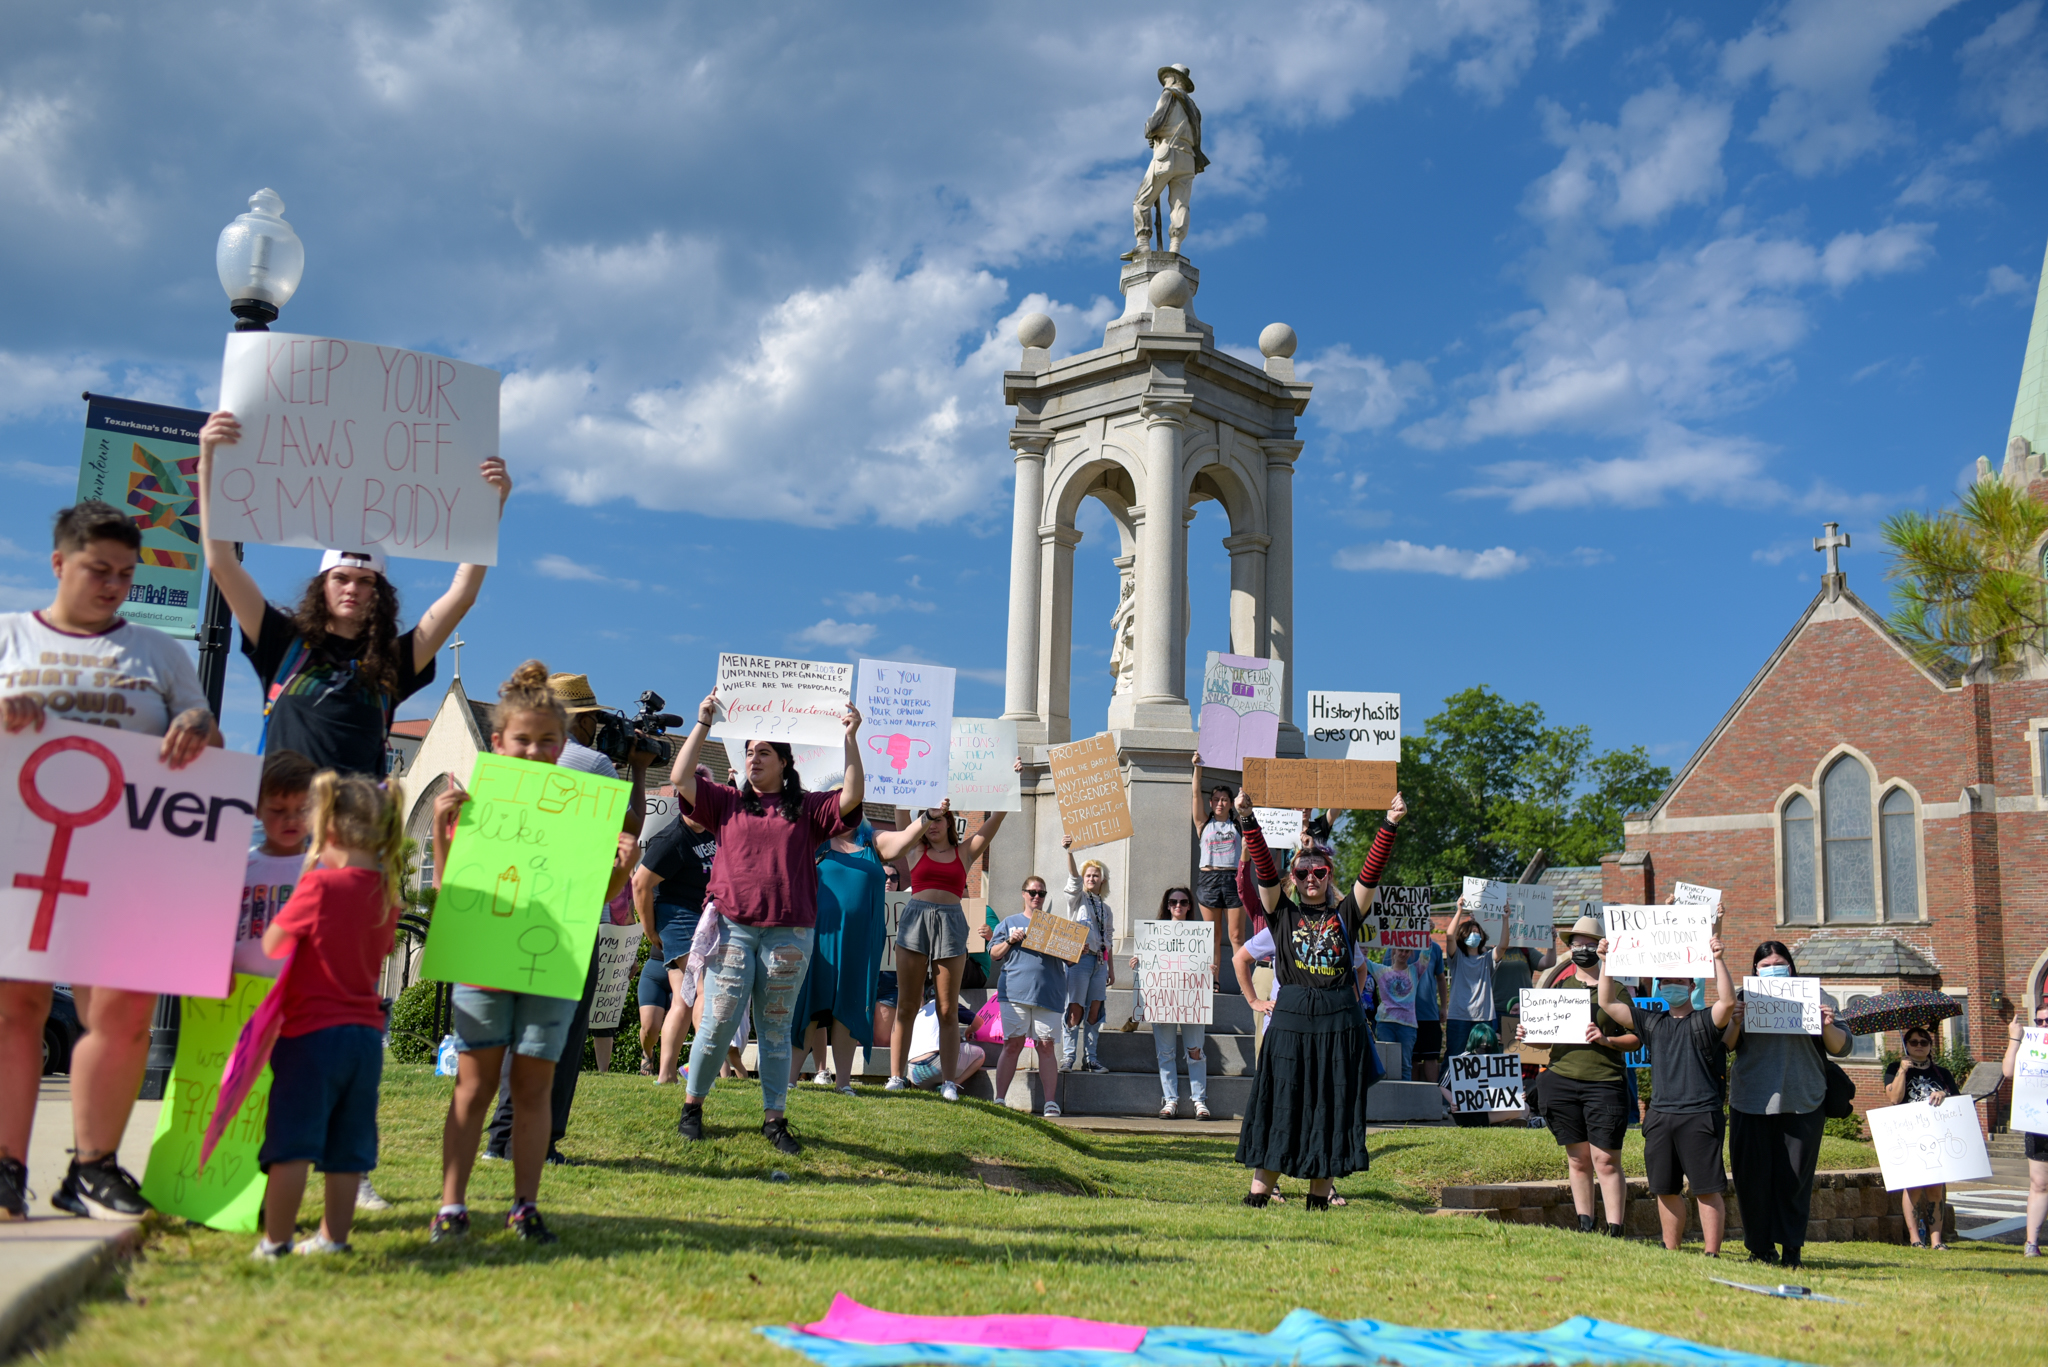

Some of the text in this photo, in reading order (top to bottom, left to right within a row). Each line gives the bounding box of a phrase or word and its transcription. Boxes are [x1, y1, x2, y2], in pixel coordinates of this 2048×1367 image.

[264, 339, 460, 421] KEEP YOUR
[162, 426, 178, 435] Old
[256, 413, 453, 474] LAWS OFF
[83, 438, 110, 503] owntown
[276, 476, 461, 551] MY BODY
[114, 609, 183, 622] kanadistrict.com
[722, 655, 848, 675] MEN ARE PART OF 100% OF
[722, 669, 843, 682] UNPLANNED PREGNANCIES
[877, 668, 921, 684] IF YOU
[722, 681, 757, 691] WHERE
[797, 683, 837, 693] PROPOSALS
[838, 688, 850, 697] FOR
[876, 685, 914, 696] DO NOT
[1206, 678, 1230, 693] LAWS
[1233, 683, 1251, 696] OFF
[869, 696, 931, 708] HAVE A UTERUS
[1232, 698, 1275, 712] DRAWERS
[1313, 695, 1399, 722] History has its
[727, 698, 773, 723] forced
[869, 706, 924, 717] YOUR OPINION
[754, 715, 798, 734] ? ? ?
[867, 717, 937, 729] DOES NOT MATTER
[960, 723, 988, 735] LIKE
[950, 737, 1000, 748] RTIONS?
[1314, 727, 1346, 742] eyes
[1373, 730, 1395, 745] you
[966, 751, 995, 760] THEM
[962, 761, 982, 771] YOU
[1055, 766, 1077, 780] UNTIL
[1078, 763, 1089, 771] THE
[1091, 758, 1108, 769] BABY
[1354, 762, 1377, 771] YEAR
[897, 778, 914, 786] LAWS
[955, 783, 1009, 793] SHOOTINGS
[1057, 767, 1119, 796] ANYTHING BUT
[873, 785, 917, 795] MY BODY
[468, 802, 549, 848] like
[1070, 816, 1121, 843] WHITE!!!
[528, 855, 549, 872] a
[1467, 878, 1499, 889] NEVER
[1680, 883, 1706, 894] PRIVACY
[1379, 886, 1430, 904] VAGINA
[1687, 892, 1712, 903] SAFETY
[1373, 901, 1430, 917] BUSINESS
[1379, 917, 1427, 930] BUZZ OFF
[1687, 915, 1696, 924] is
[1700, 916, 1708, 924] a
[1143, 922, 1212, 938] This Country
[1135, 938, 1157, 951] Was
[1158, 938, 1185, 953] Built
[1380, 931, 1430, 949] BARRETT
[1650, 930, 1670, 946] YOU
[599, 950, 636, 964] CHOICE
[1152, 954, 1198, 971] ASHES
[1200, 955, 1212, 971] of
[1638, 952, 1646, 963] IF
[1650, 951, 1681, 964] WOMEN
[1145, 971, 1210, 990] OVERTHROWN
[1747, 979, 1814, 998] UNSAFE
[596, 995, 622, 1008] BODY
[1133, 988, 1210, 1009] TYRANNICAL
[1558, 994, 1591, 1005] Abortions
[1133, 1006, 1210, 1023] GOVERNMENT
[1745, 1001, 1817, 1015] ABORTIONS
[1522, 1011, 1551, 1022] Doesn't
[1747, 1016, 1772, 1029] KILL
[1773, 1016, 1802, 1030] 22,800
[1802, 1023, 1821, 1031] YEAR
[1452, 1055, 1519, 1081] PRO-LIFE
[1454, 1086, 1522, 1112] PRO-VAX
[1915, 1113, 1931, 1128] My
